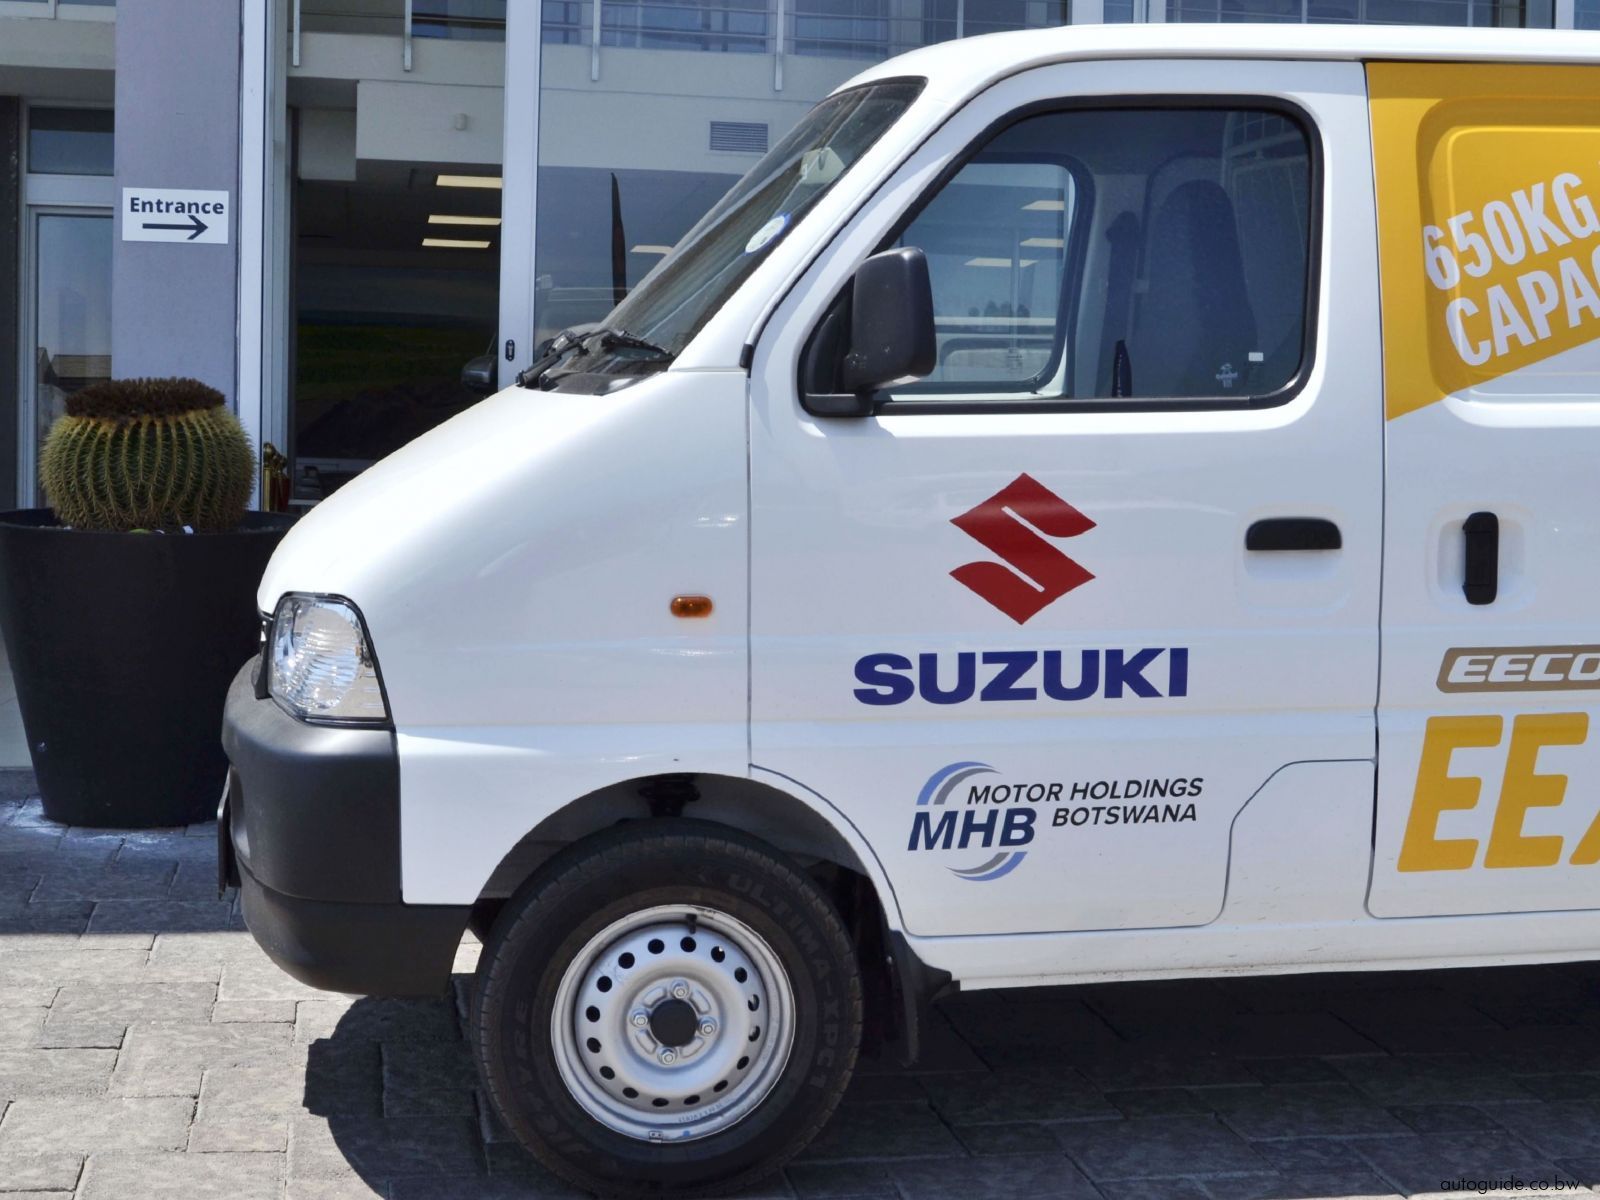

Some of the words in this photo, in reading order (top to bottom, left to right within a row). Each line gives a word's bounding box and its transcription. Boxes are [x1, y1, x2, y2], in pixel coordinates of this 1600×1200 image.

[130, 197, 224, 215] Entrance
[1422, 172, 1600, 290] 650KG
[1445, 244, 1600, 366] CAPA
[853, 647, 1189, 706] SUZUKI
[1447, 653, 1600, 683] EECO
[967, 783, 1063, 805] MOTOR
[1070, 778, 1204, 801] HOLDINGS
[1397, 712, 1600, 872] EE
[907, 807, 1037, 851] MHB
[1052, 804, 1197, 827] BOTSWANA
